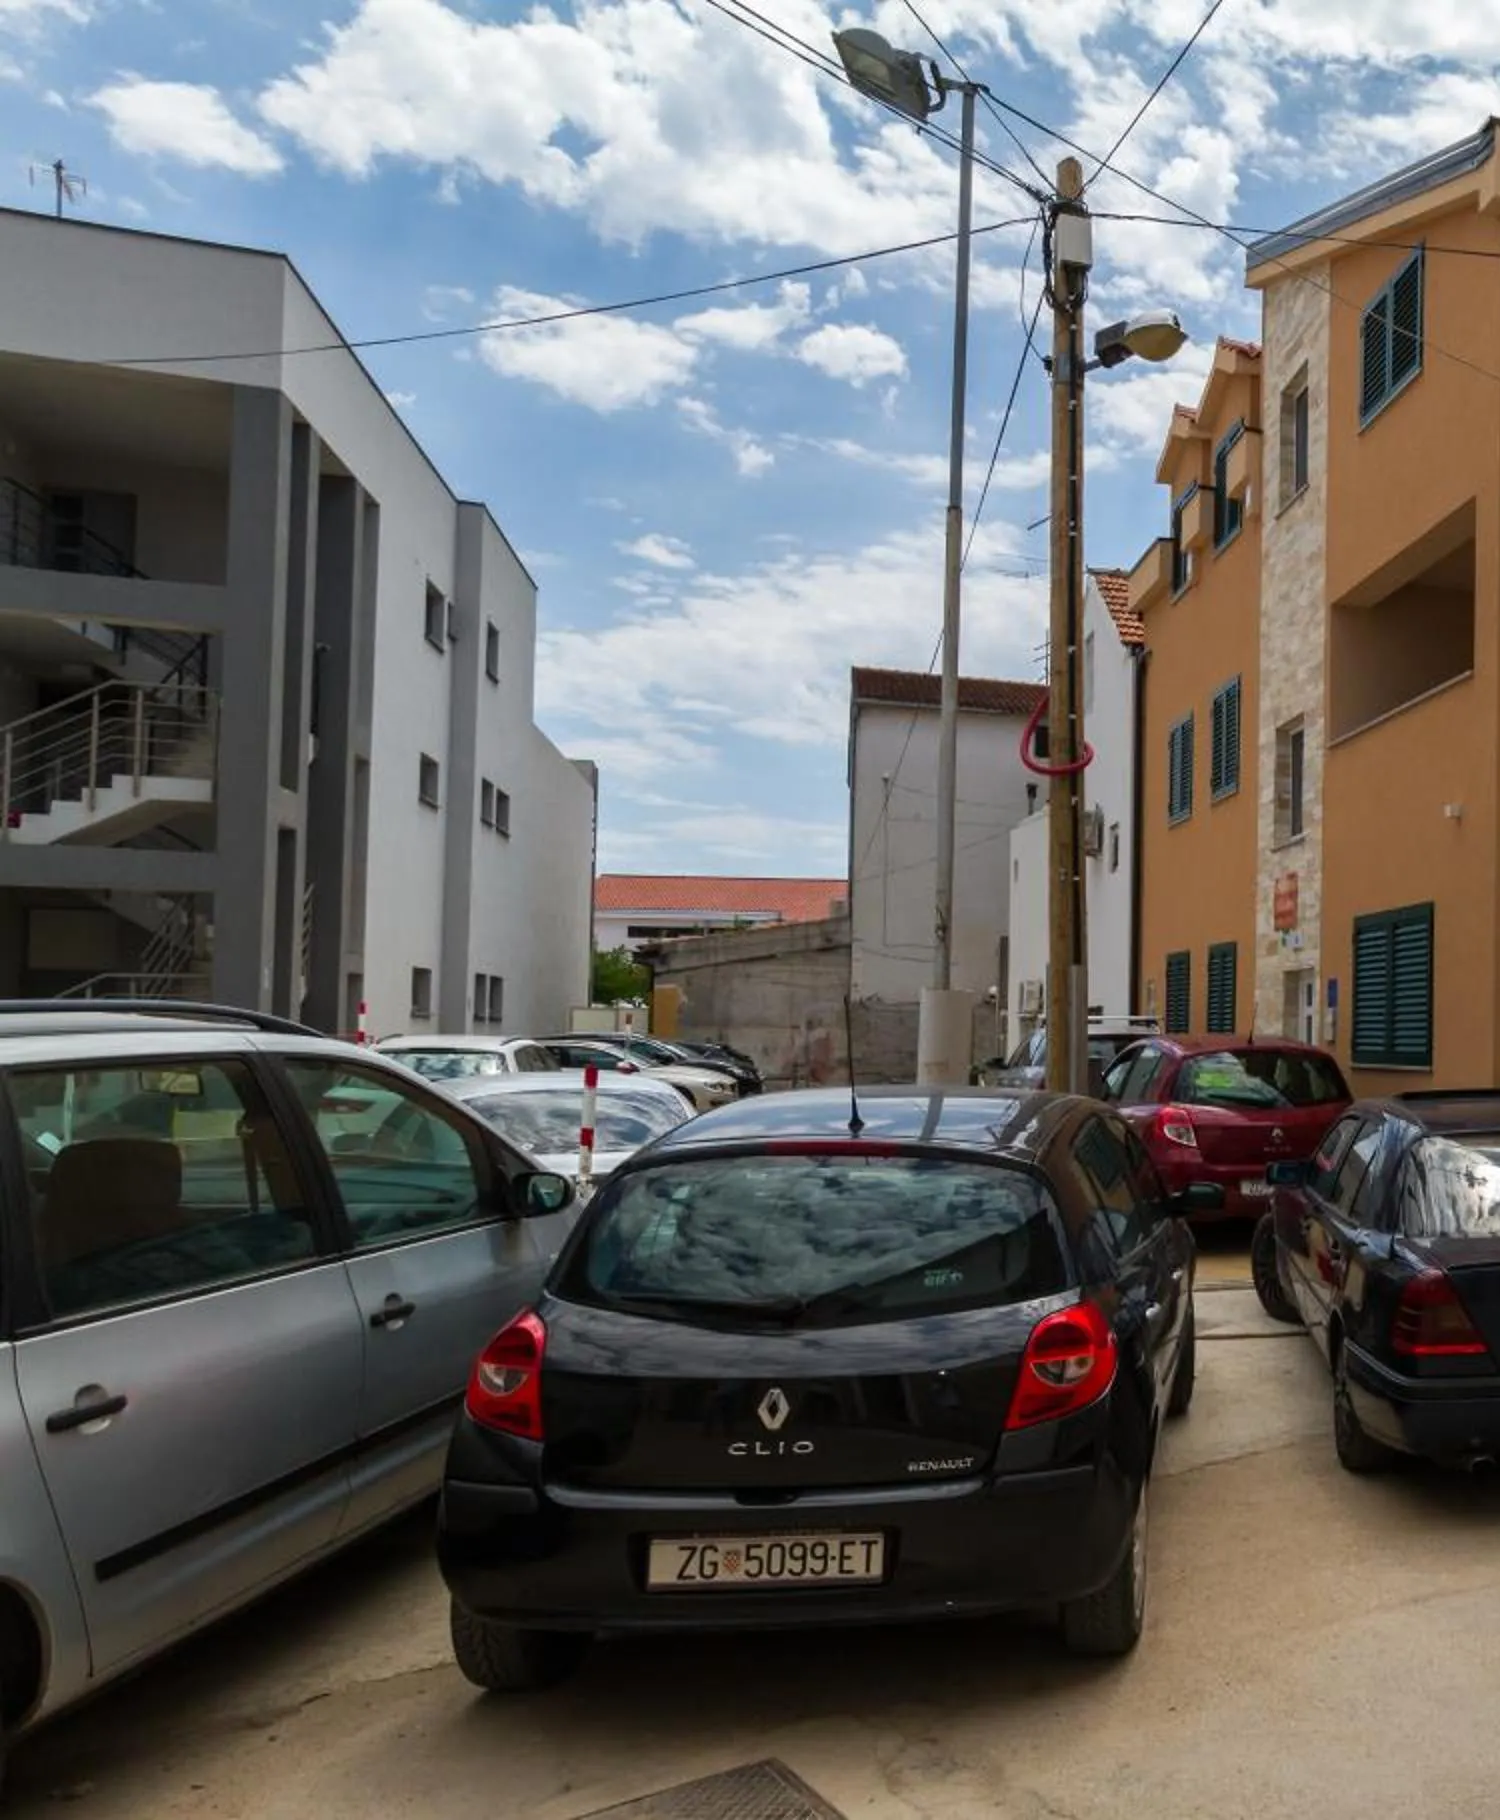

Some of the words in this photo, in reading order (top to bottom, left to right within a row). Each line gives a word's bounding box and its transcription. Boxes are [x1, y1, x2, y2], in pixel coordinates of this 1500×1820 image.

[728, 1441, 815, 1455] CLIO
[908, 1457, 975, 1473] RENAULT
[676, 1545, 720, 1581] ZG
